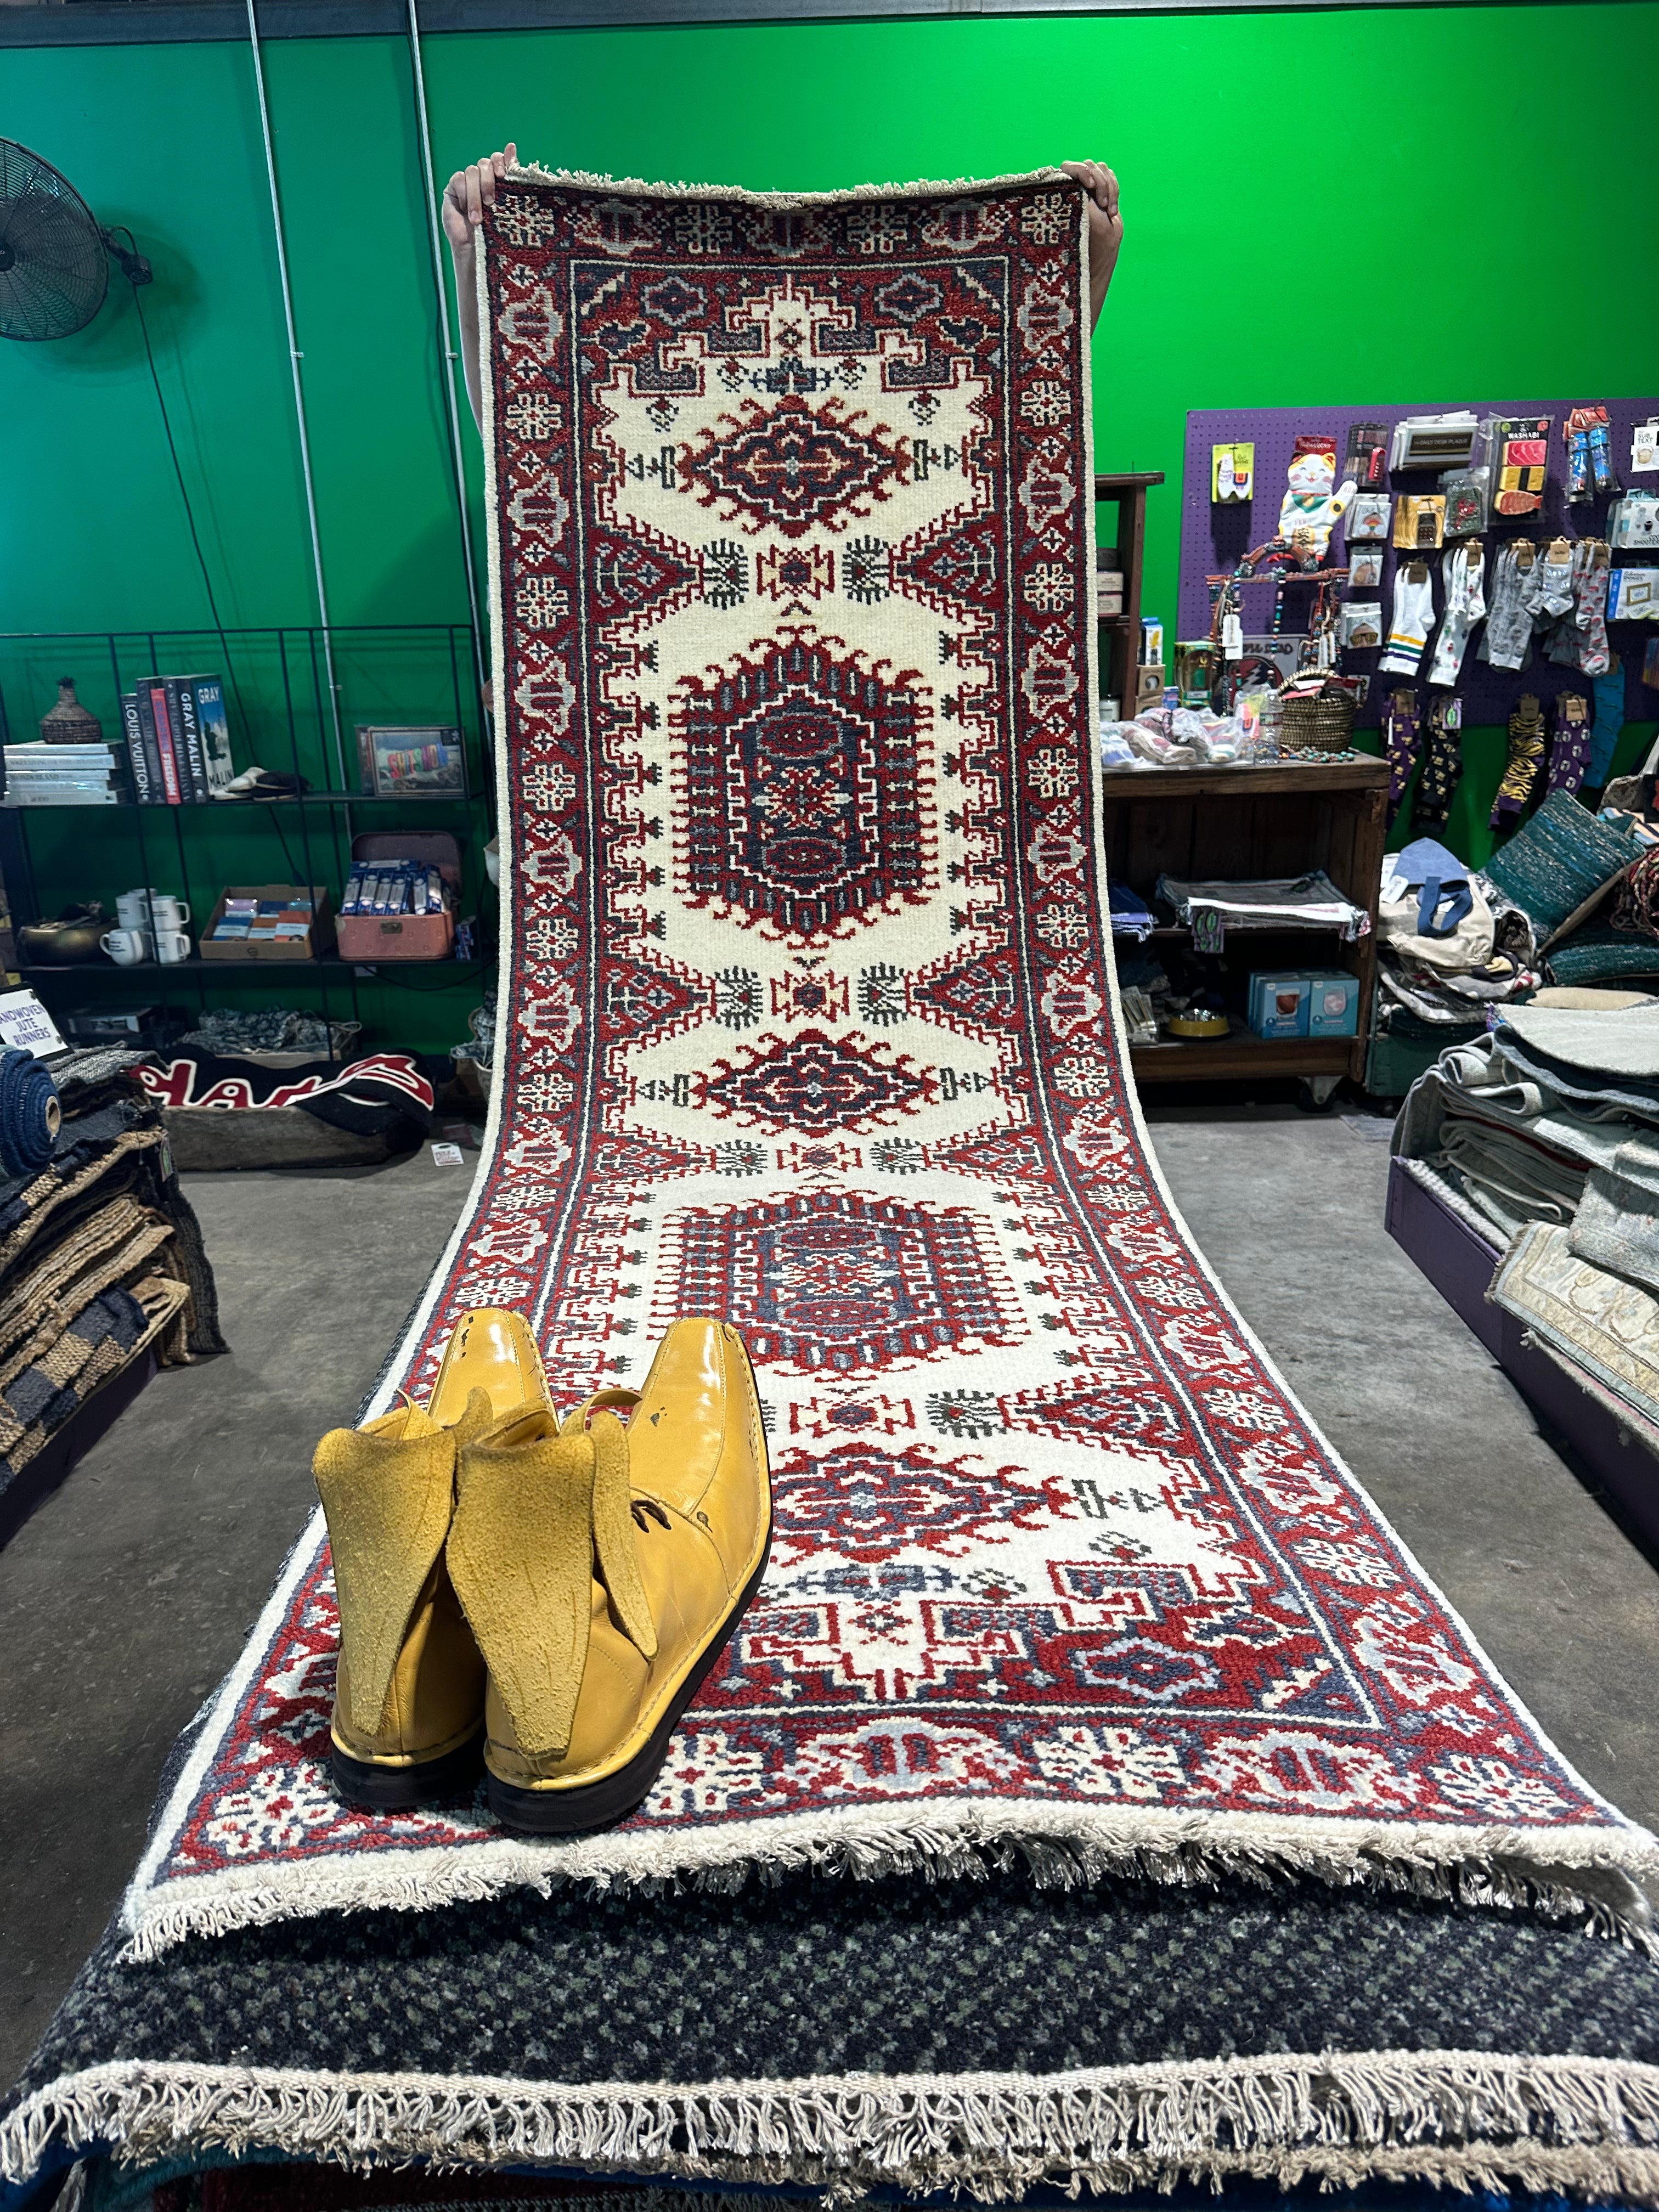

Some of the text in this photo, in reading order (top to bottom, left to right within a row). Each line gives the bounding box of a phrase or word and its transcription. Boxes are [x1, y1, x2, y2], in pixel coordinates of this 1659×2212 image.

[198, 687, 220, 704] GRAY
[125, 703, 150, 794] LOUIS VUITTON
[181, 693, 202, 777] GRAY MALIN
[162, 753, 177, 796] FREEDOM
[13, 1027, 50, 1046] RUNNERS
[15, 1018, 38, 1033] JUTE
